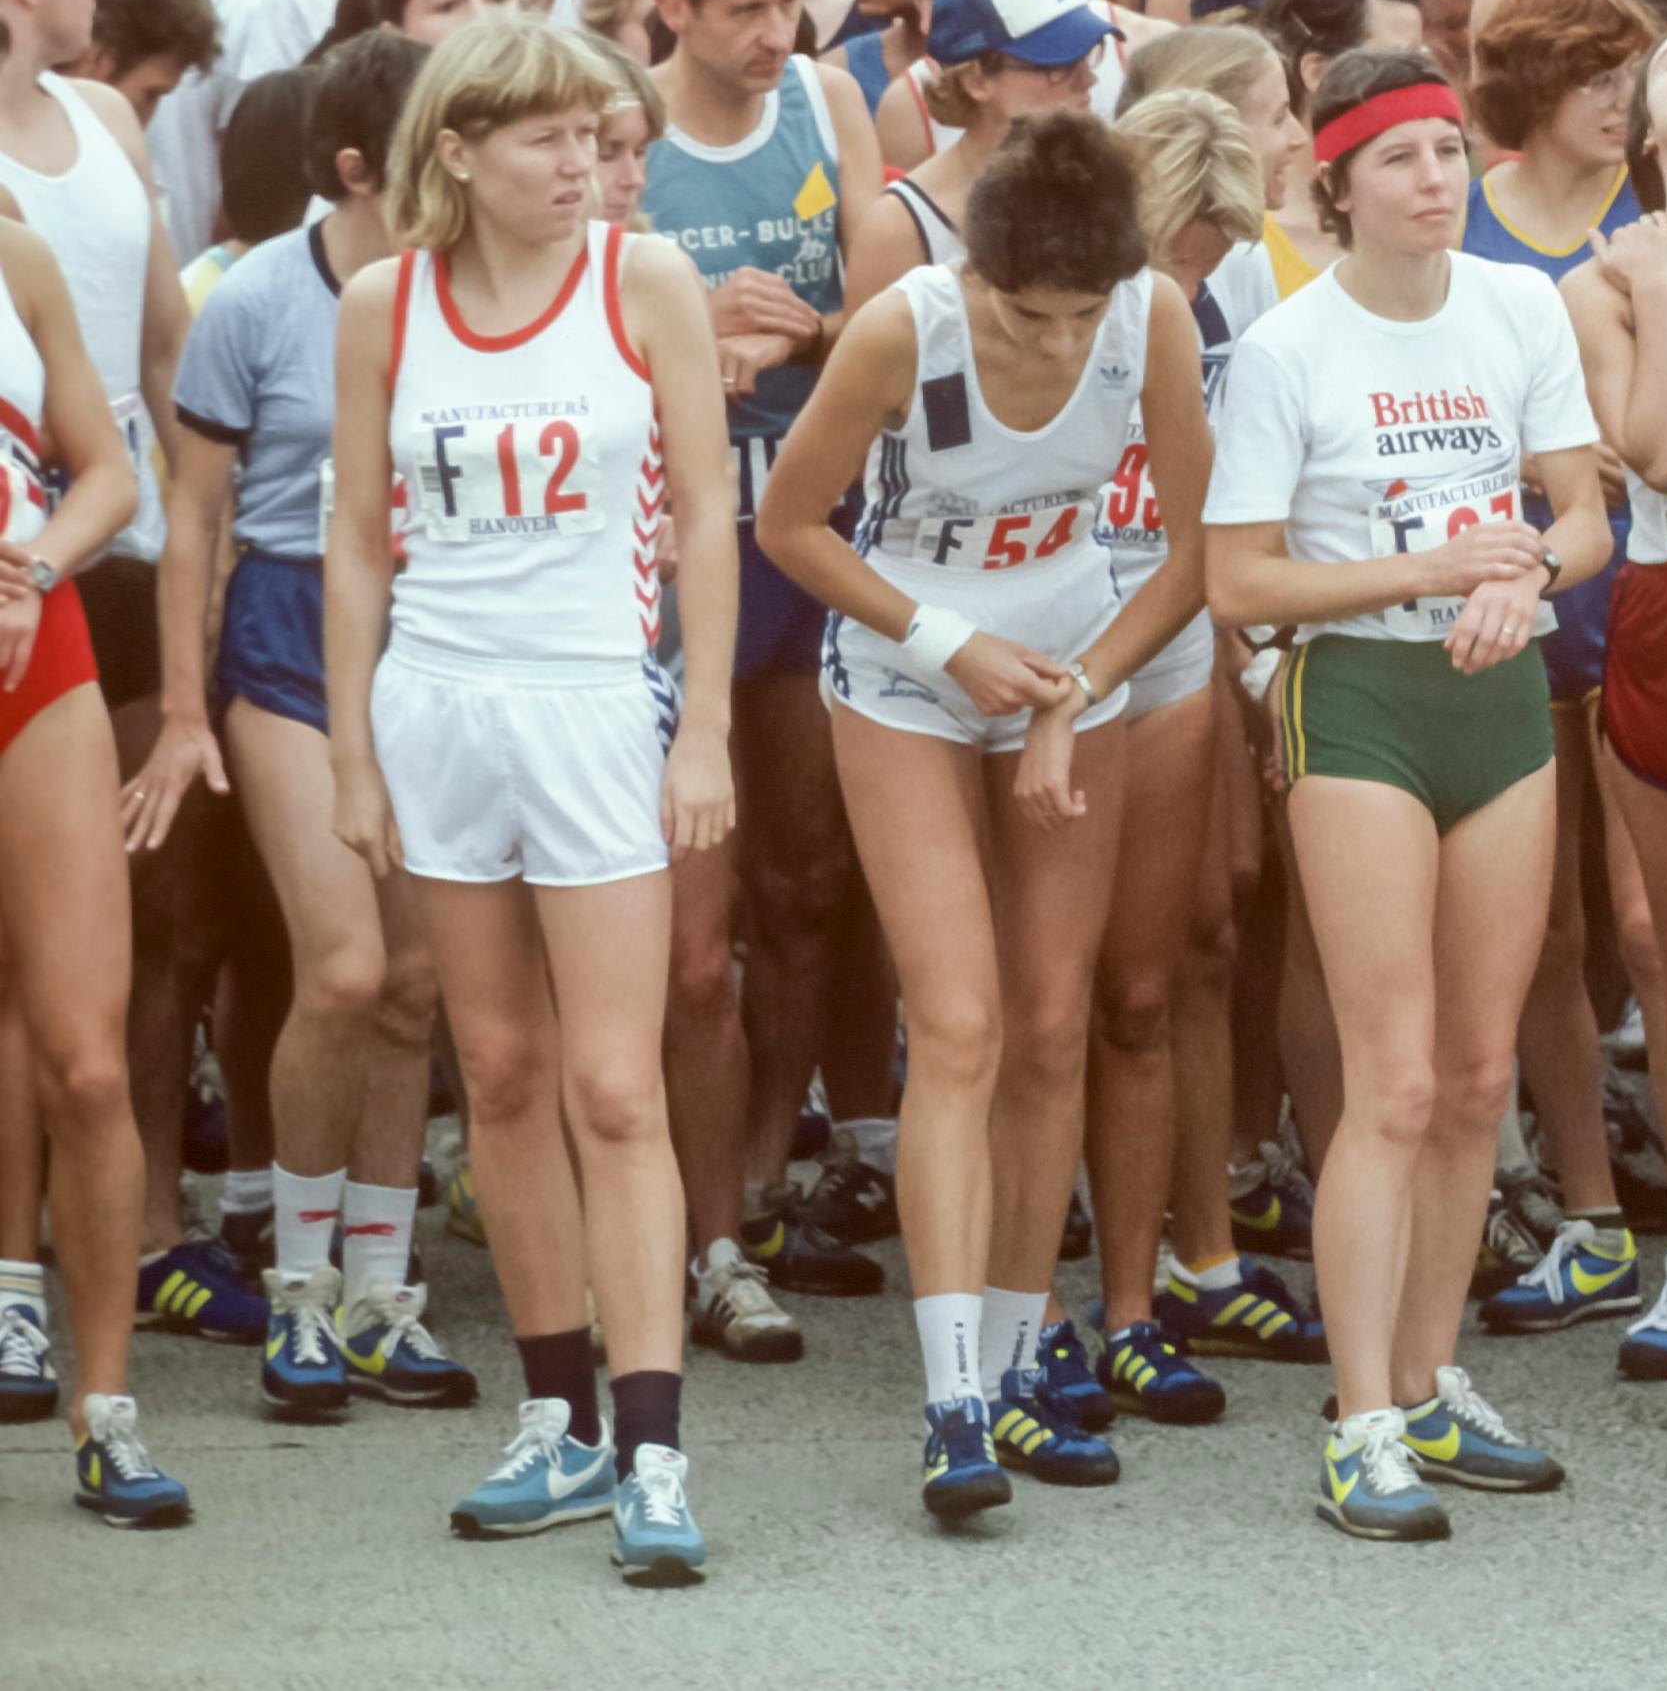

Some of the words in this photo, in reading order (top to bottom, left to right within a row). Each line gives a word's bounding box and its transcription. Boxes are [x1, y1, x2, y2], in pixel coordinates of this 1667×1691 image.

[1368, 385, 1489, 427] British
[1376, 425, 1502, 457] airways
[497, 420, 589, 518] 12
[469, 515, 558, 535] HANOVER
